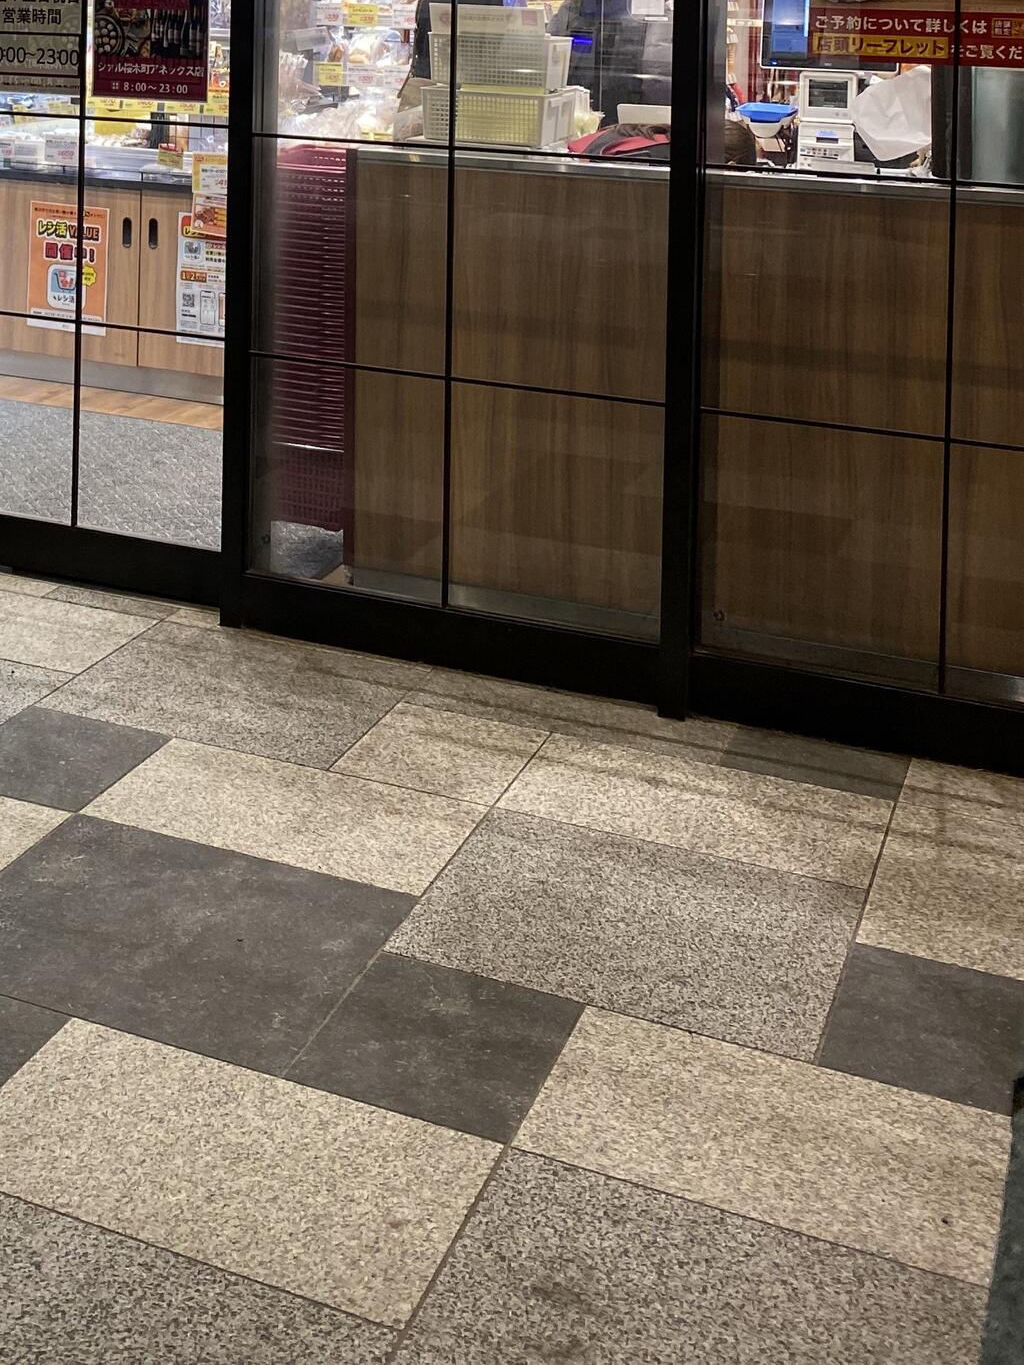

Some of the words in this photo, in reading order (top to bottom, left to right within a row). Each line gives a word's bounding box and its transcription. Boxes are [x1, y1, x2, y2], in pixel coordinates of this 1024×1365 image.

[2, 7, 62, 25] 営業時間
[815, 14, 987, 35] ご予約について詳しくは
[816, 36, 945, 57] 店頭リーフレット
[38, 220, 100, 241] レシ活VLUE
